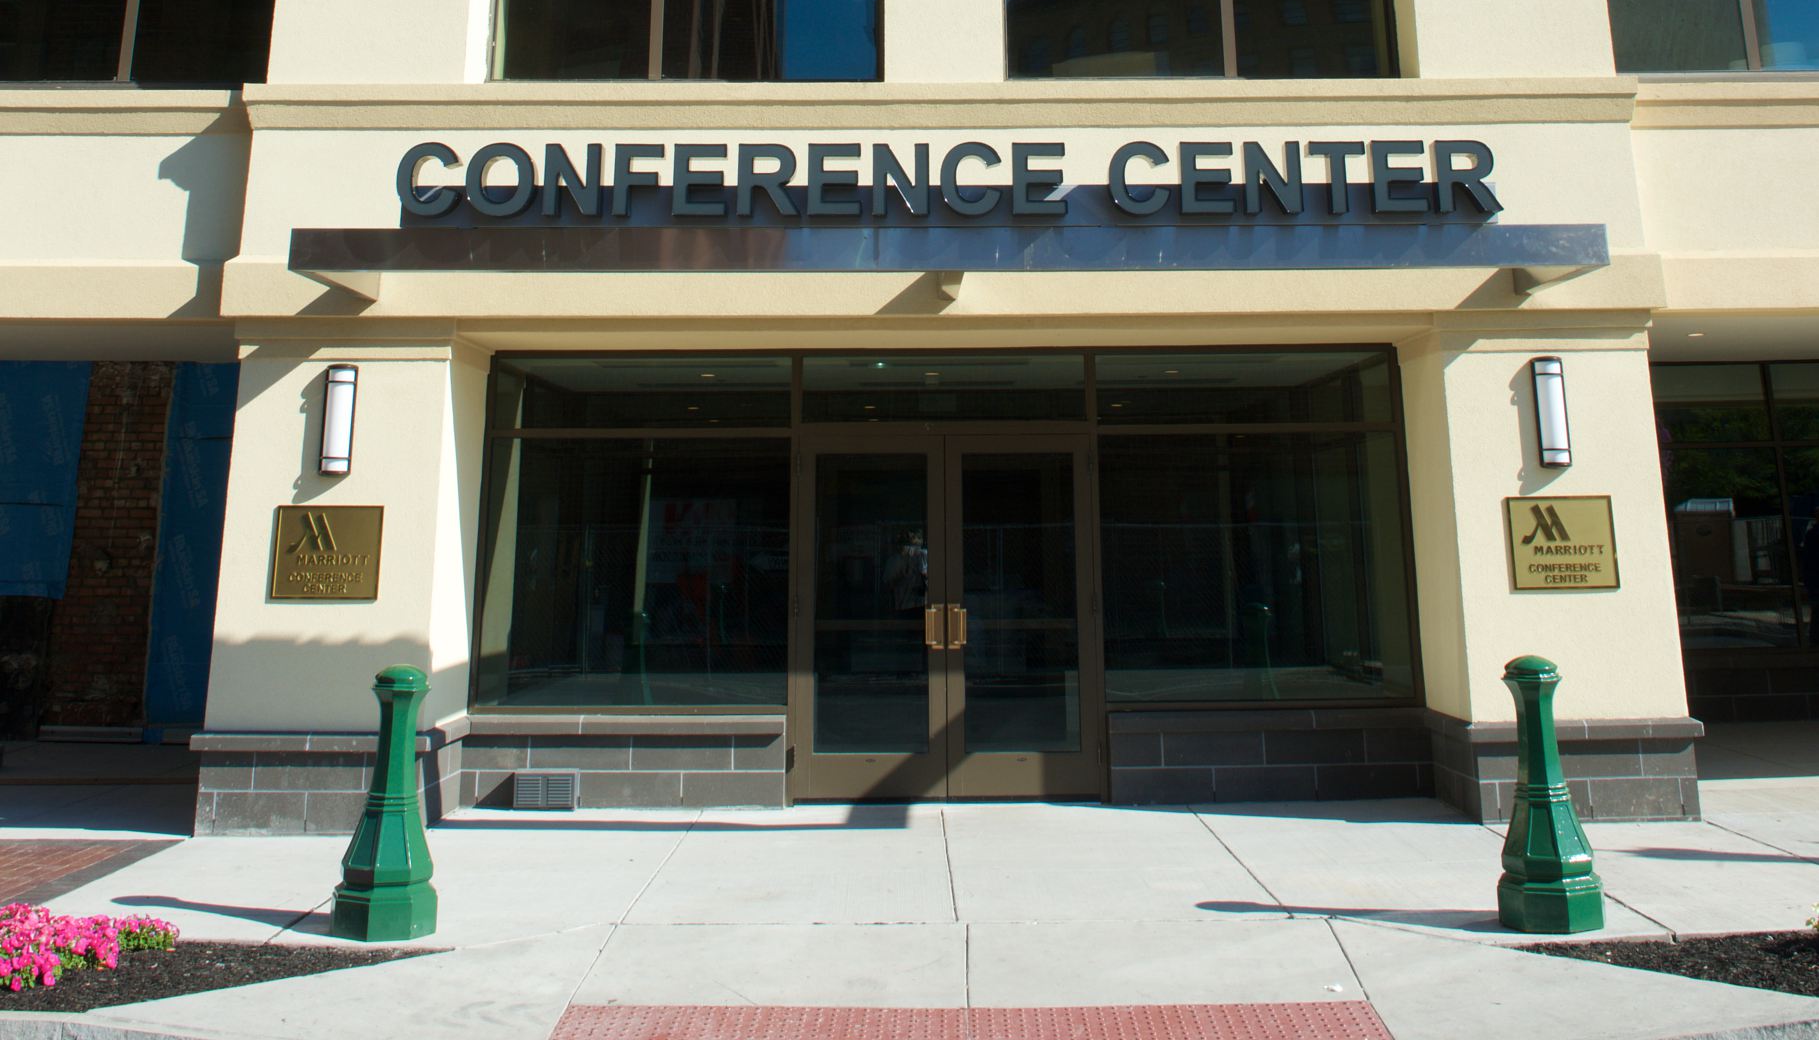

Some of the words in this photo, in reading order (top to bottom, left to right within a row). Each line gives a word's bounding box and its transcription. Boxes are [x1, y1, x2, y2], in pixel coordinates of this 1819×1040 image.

[397, 142, 1068, 217] CONFERENCE
[1109, 140, 1503, 216] CENTER
[1533, 544, 1605, 556] MARRIOTT
[297, 554, 370, 566] MARRIOTT
[1528, 562, 1602, 574] CONFERENCE
[288, 572, 364, 583] CONFERENCE
[1544, 573, 1588, 585] CENTER
[303, 583, 347, 594] CENTER
